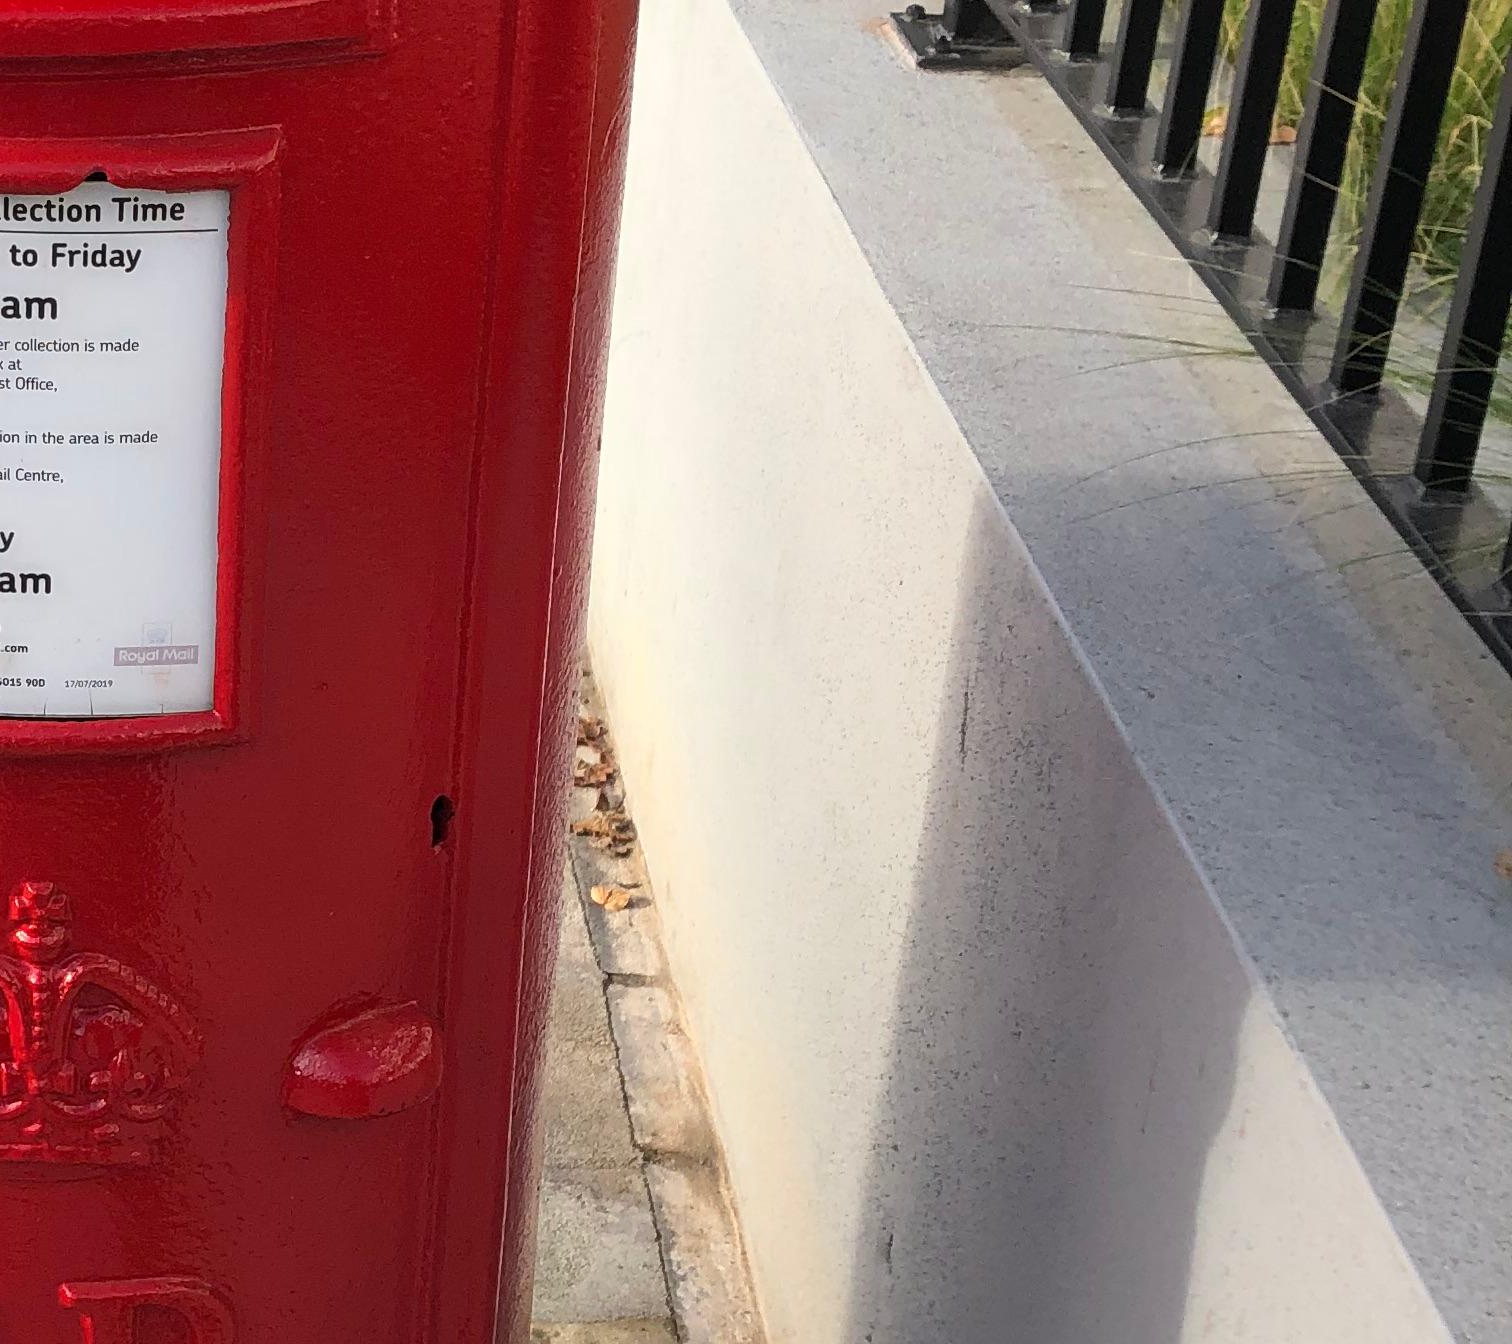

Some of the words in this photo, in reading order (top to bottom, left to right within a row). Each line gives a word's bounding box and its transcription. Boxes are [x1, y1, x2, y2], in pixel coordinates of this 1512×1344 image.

[111, 195, 185, 223] Time
[8, 243, 39, 268] to
[51, 242, 143, 274] Friday
[14, 337, 80, 353] collection
[84, 338, 96, 353] is
[99, 337, 140, 353] made
[7, 358, 23, 371] at
[15, 376, 58, 393] Office,
[24, 430, 38, 445] in
[41, 431, 65, 445] the
[68, 434, 100, 445] area
[103, 431, 115, 445] is
[119, 430, 159, 444] made
[15, 467, 64, 484] Centre,
[118, 649, 160, 664] Royal
[162, 647, 195, 662] Mail
[63, 679, 114, 689] 17/07/2019
